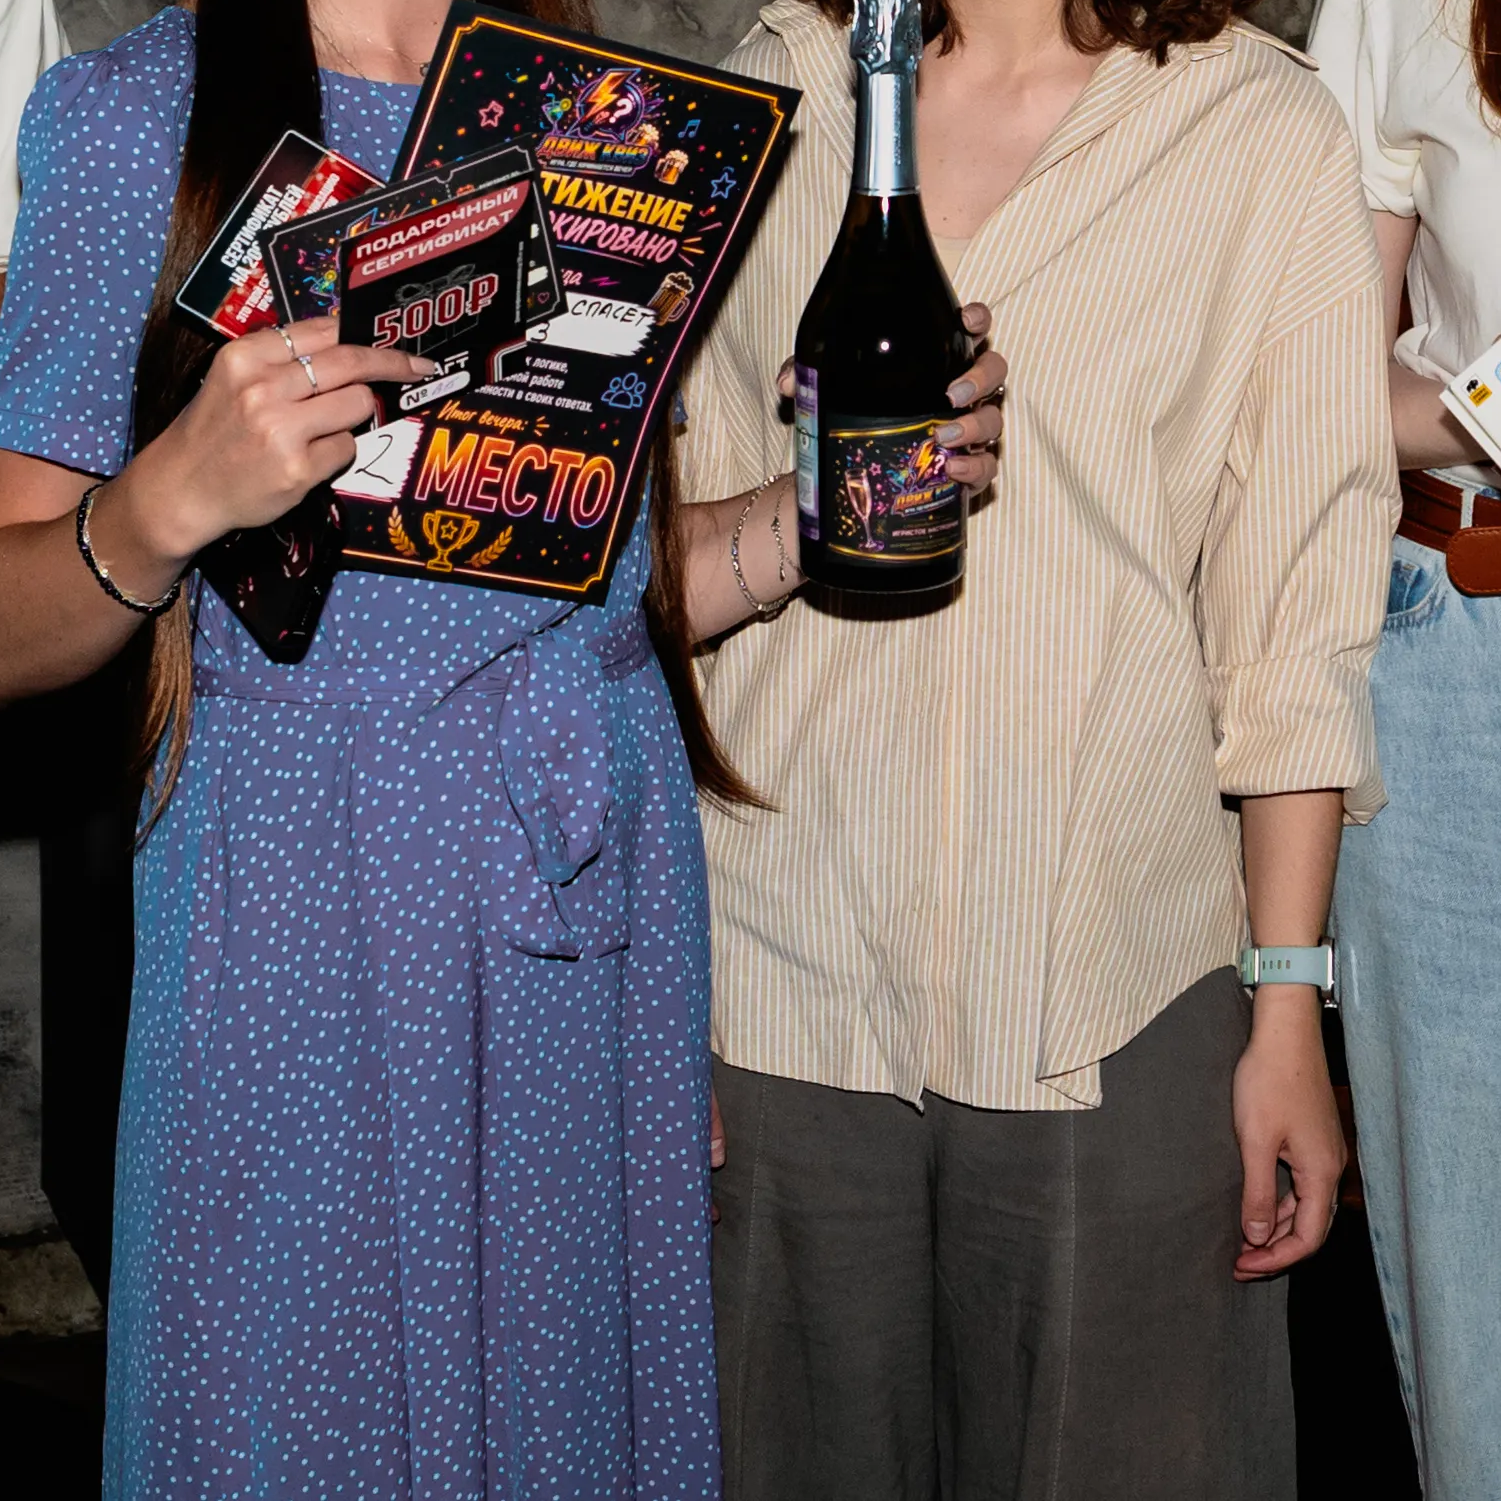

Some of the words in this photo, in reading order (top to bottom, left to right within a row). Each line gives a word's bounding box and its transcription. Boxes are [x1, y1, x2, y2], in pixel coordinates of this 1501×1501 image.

[537, 137, 600, 160] ДВИЖ
[220, 183, 285, 270] СЕРТИФИКАТ
[356, 187, 518, 259] ПОДАРОЧНЫЙ
[540, 171, 693, 233] ТИЖЕНИЕ
[362, 209, 514, 276] СЕРТИФИКАТ
[549, 210, 678, 263] КИРОВАНО
[228, 264, 252, 288] НА
[529, 375, 565, 390] работе
[532, 357, 568, 373] логике,
[437, 400, 473, 421] Итог
[478, 408, 529, 434] вечера:
[475, 385, 514, 400] нности
[517, 390, 522, 400] в
[525, 392, 553, 405] своих
[555, 397, 593, 413] ответах.
[355, 434, 394, 485] 2
[414, 427, 616, 529] МЕСТО
